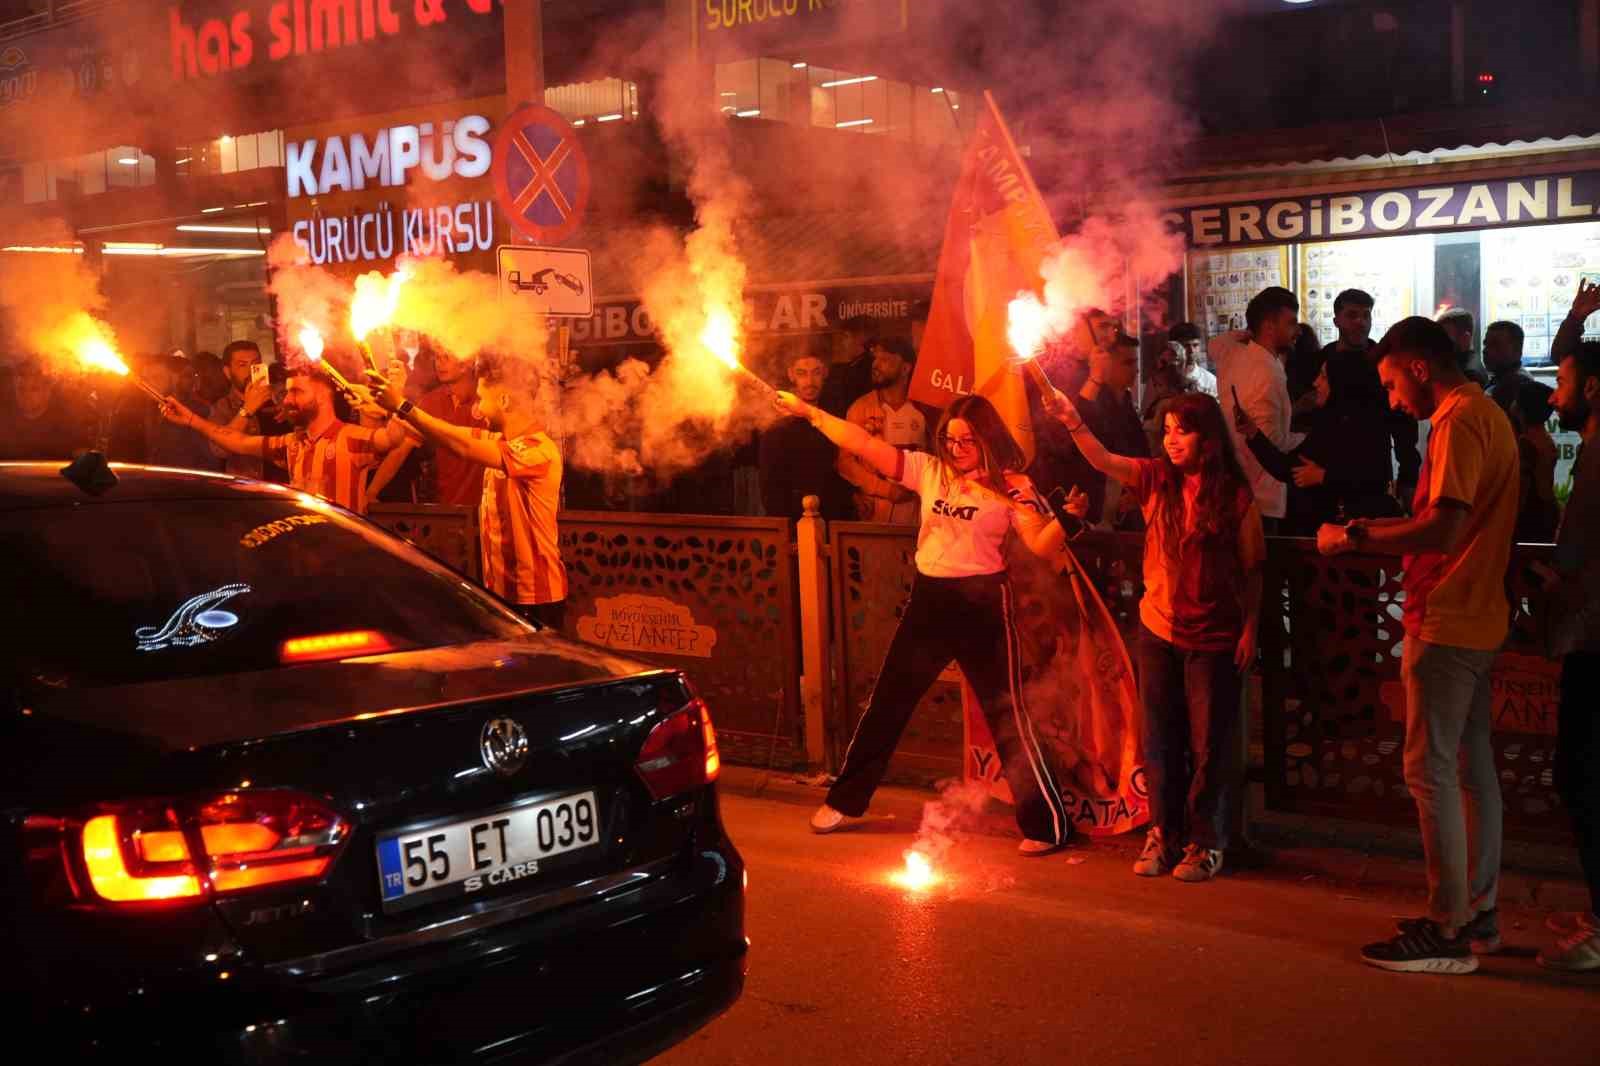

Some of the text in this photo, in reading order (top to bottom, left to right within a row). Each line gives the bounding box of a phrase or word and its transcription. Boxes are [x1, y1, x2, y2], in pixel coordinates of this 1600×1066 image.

[169, 6, 254, 82] has
[286, 115, 492, 198] KAMPÜS
[293, 200, 493, 265] SÜRÜCÜ KURSU
[402, 798, 594, 888] 55 ET 039
[487, 860, 540, 886] CARS
[385, 869, 402, 888] TR
